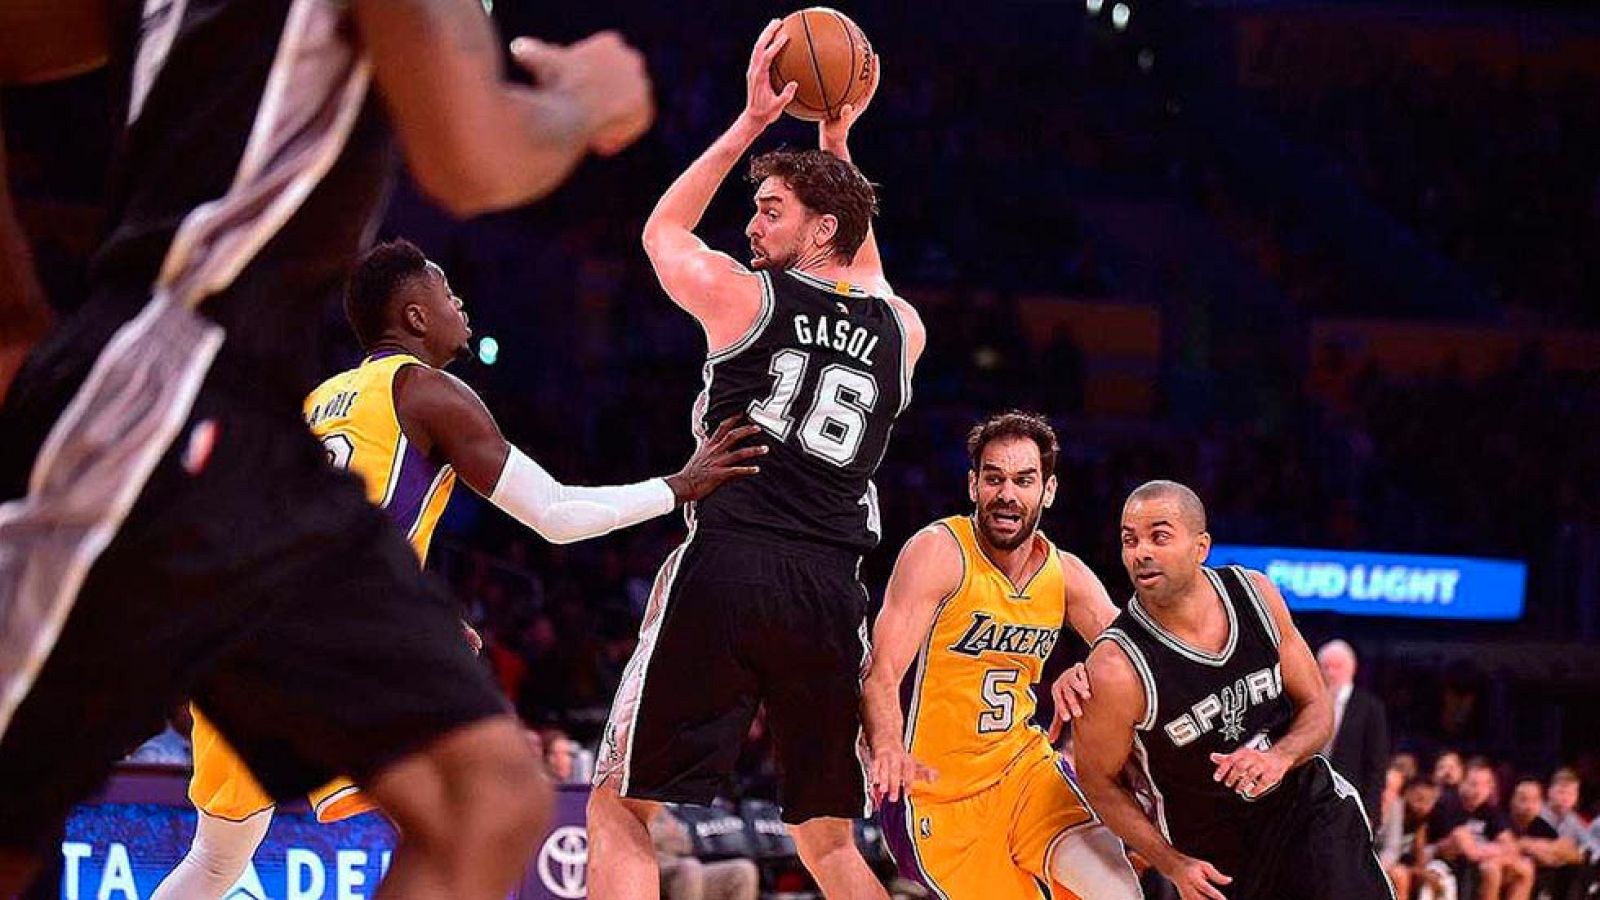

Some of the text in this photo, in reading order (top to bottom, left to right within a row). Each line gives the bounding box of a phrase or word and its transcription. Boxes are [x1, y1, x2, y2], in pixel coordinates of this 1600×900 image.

[793, 314, 879, 366] GASOL
[746, 347, 879, 468] 16
[1349, 564, 1459, 604] LIGHT
[977, 668, 1020, 734] 5
[1163, 662, 1283, 748] SPUR
[287, 848, 392, 900] DE
